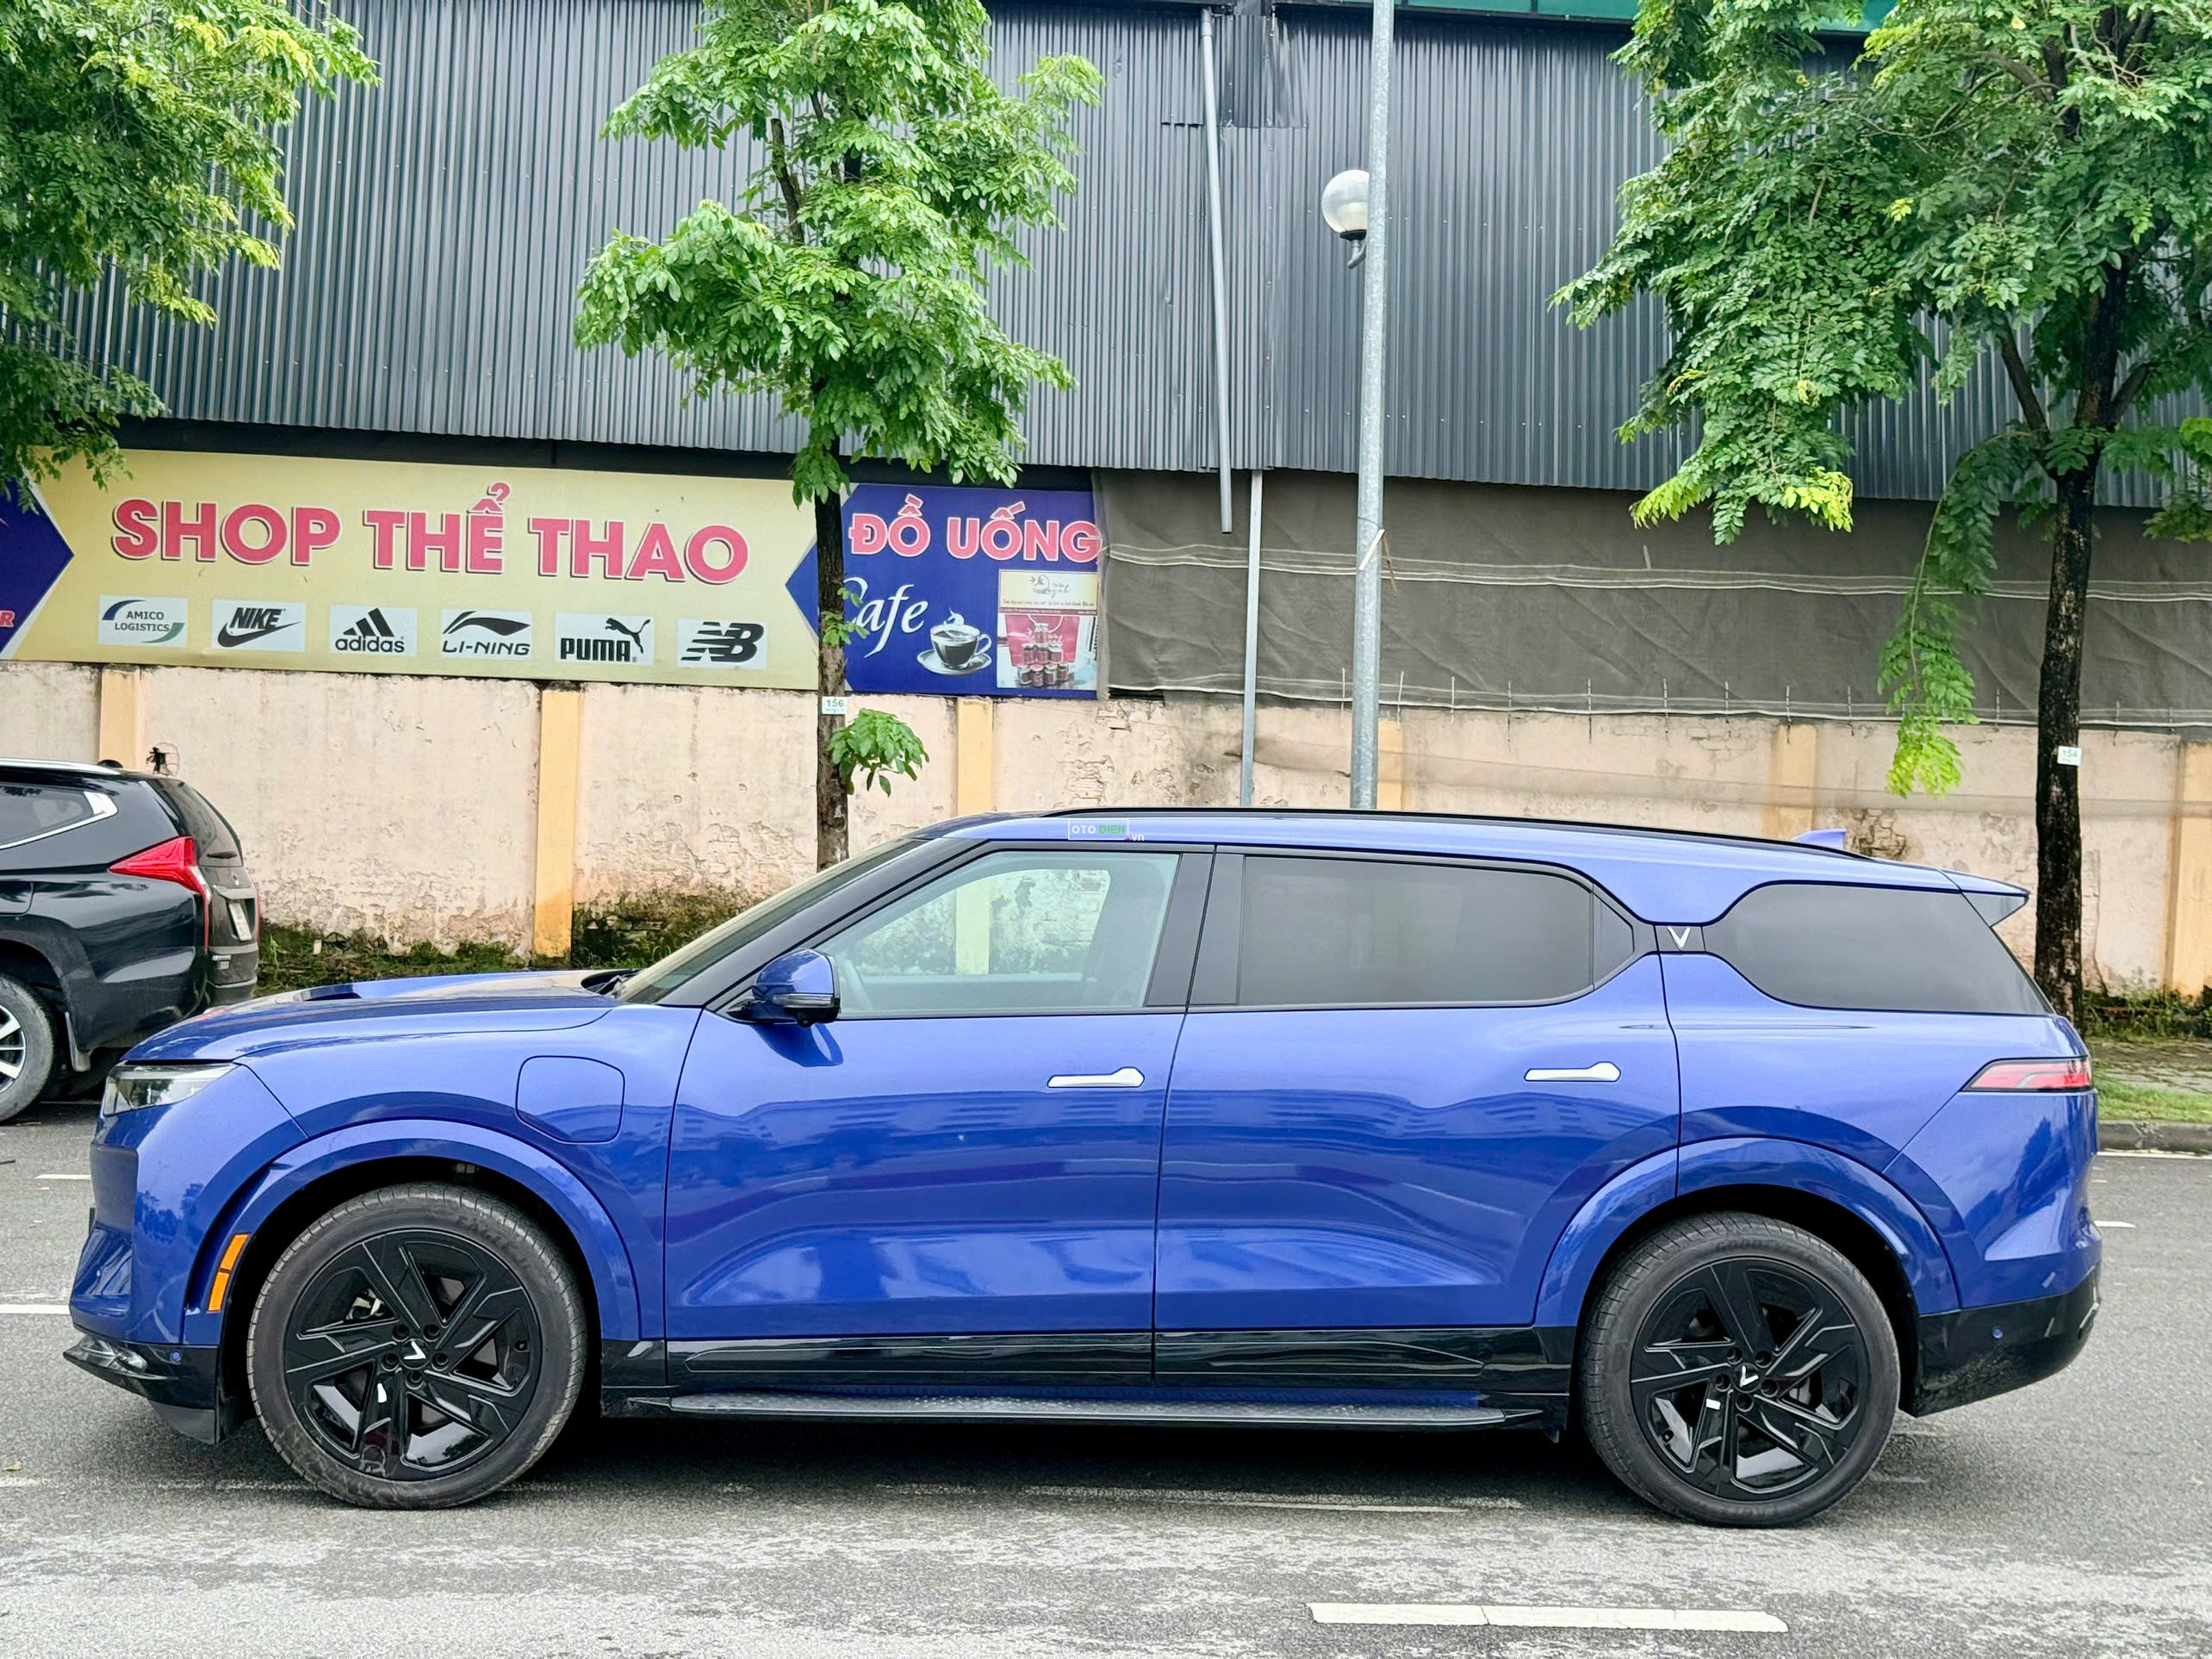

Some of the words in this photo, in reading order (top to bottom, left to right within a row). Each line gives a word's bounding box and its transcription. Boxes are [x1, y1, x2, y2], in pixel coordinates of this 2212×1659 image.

[112, 498, 341, 567] SHOP
[362, 482, 511, 574] THỂ
[528, 517, 750, 585] THAO
[848, 493, 931, 557] ĐỒ
[948, 500, 1103, 563] UỐNG
[126, 611, 165, 620] AMICO
[229, 606, 283, 630] NIKE
[115, 621, 171, 632] LOGISTICS
[335, 635, 405, 653] adidas
[442, 641, 531, 656] LI-NING
[560, 637, 631, 662] PUMA
[826, 699, 845, 707] 156
